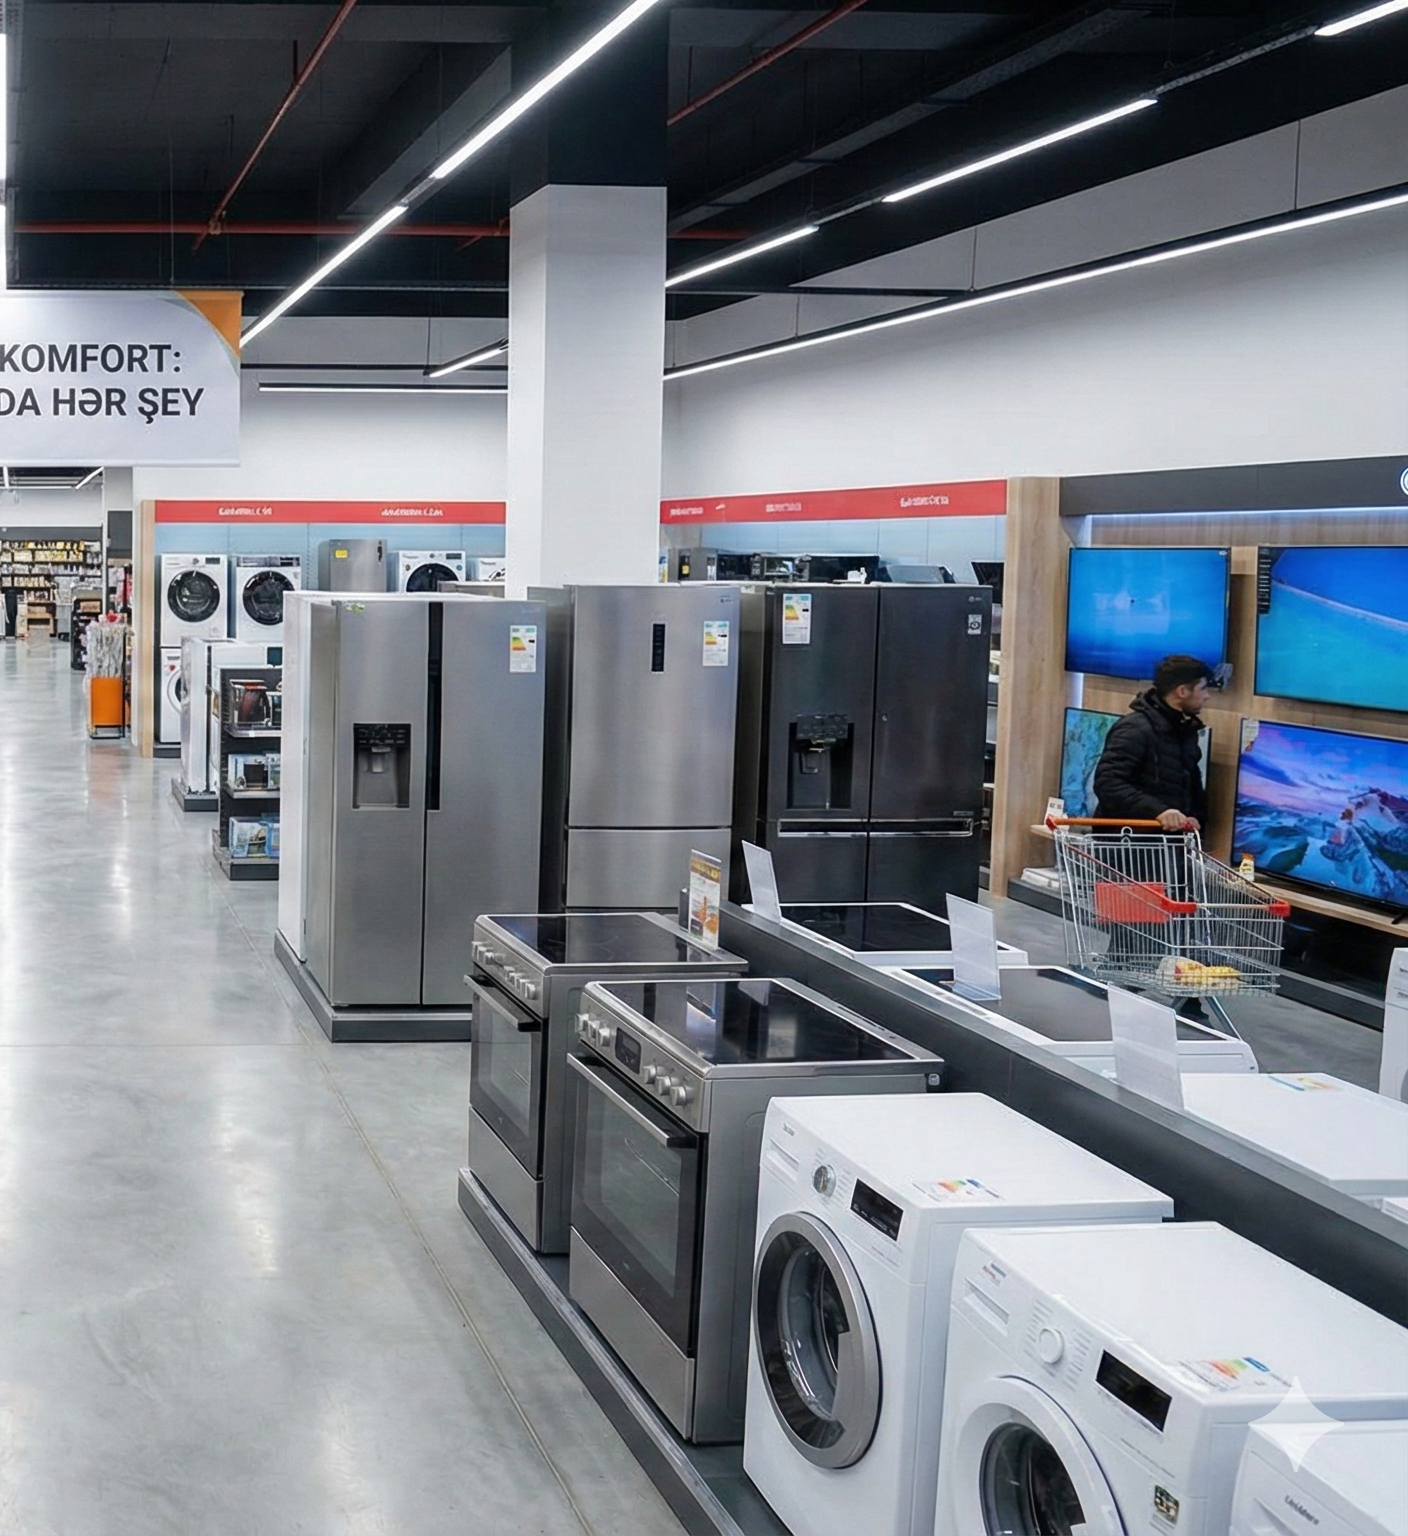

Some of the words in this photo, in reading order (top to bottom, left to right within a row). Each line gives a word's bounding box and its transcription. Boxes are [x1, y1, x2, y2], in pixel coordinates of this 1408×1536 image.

[0, 343, 181, 373] KOMFORT:
[53, 387, 127, 417] HƏR
[137, 387, 205, 425] ŞEY
